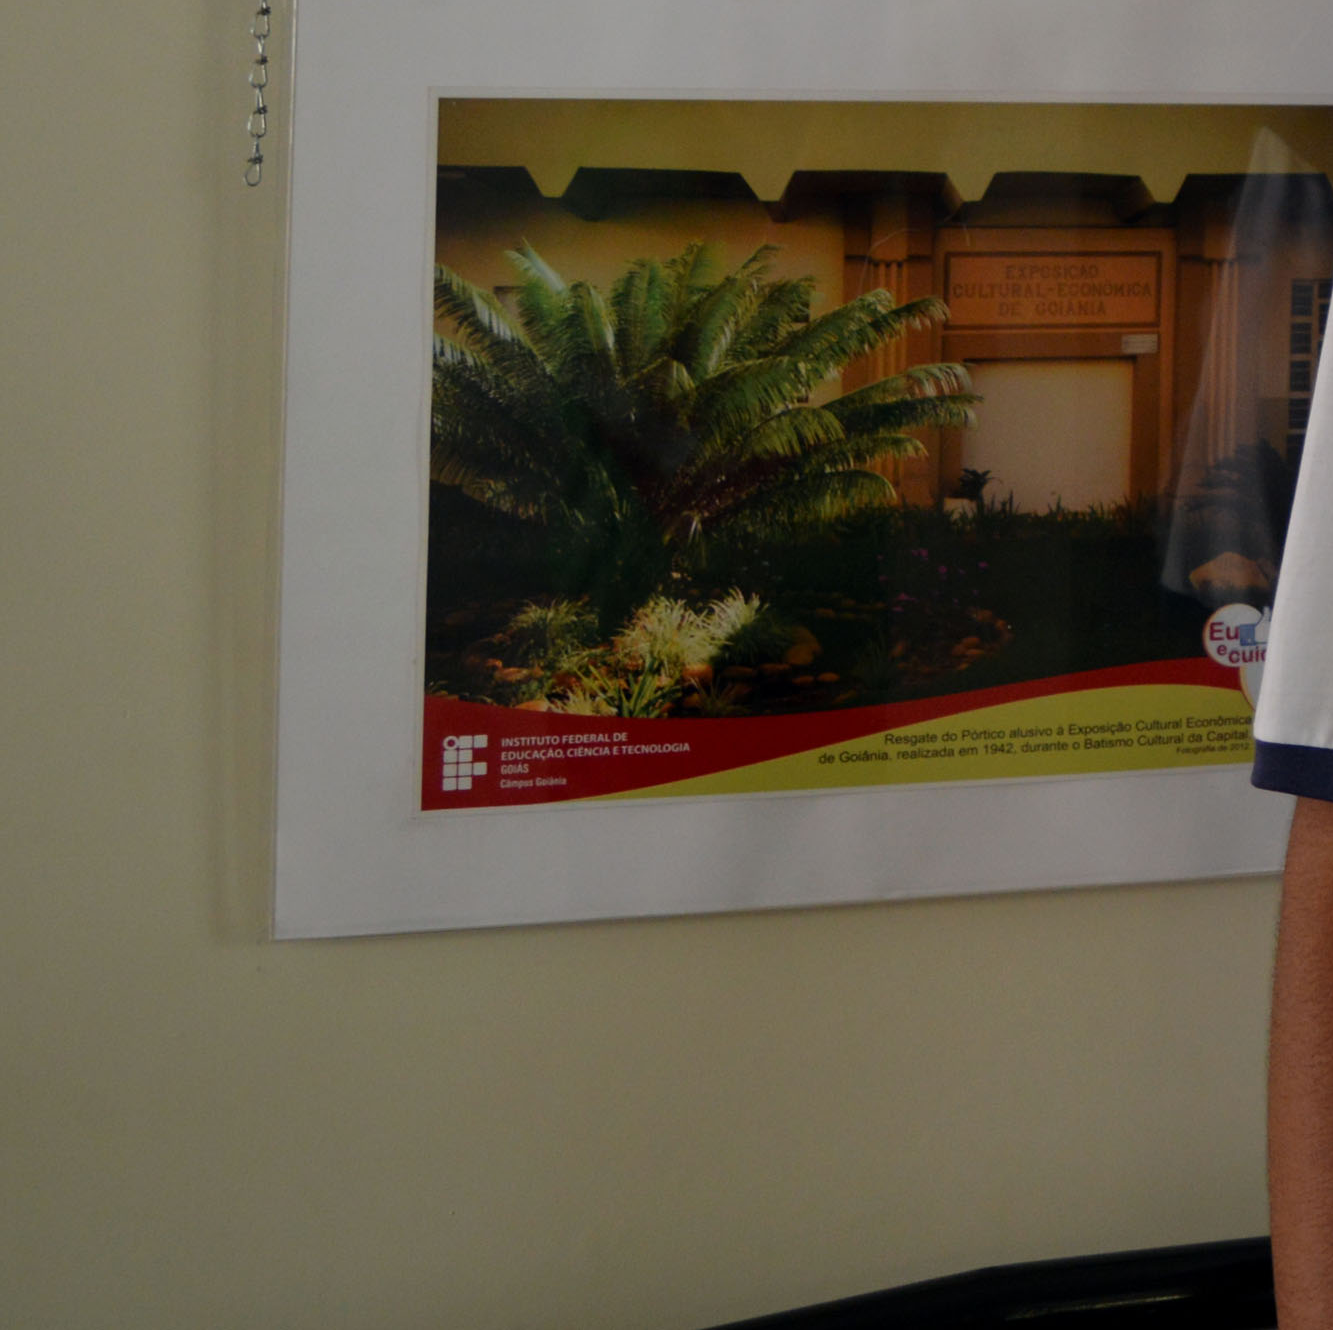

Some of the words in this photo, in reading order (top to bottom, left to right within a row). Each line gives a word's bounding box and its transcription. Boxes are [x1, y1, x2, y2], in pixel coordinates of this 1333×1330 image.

[999, 301, 1022, 316] DE
[1209, 621, 1240, 641] Eu
[1216, 644, 1227, 656] e
[501, 734, 560, 748] INSTITUTO
[562, 732, 611, 745] FEDERAL
[612, 731, 628, 742] DE
[884, 732, 939, 747] Resgate
[941, 730, 958, 743] do
[962, 728, 1005, 742] Pórtico
[1009, 725, 1053, 739] alusivo
[1068, 721, 1132, 737] Exposição
[1135, 718, 1182, 732] Cultural
[1186, 715, 1253, 729] Econômica
[501, 748, 565, 762] EDUCAÇÃO,
[567, 744, 610, 758] CIÊNCIA
[613, 745, 620, 756] E
[621, 742, 691, 756] TECNOLOGIA
[818, 752, 835, 765] de
[839, 749, 893, 763] Goiânia,
[896, 745, 955, 760] realizada
[958, 746, 978, 757] em
[984, 742, 1017, 756] 1942,
[1020, 739, 1068, 754] durante
[1071, 739, 1080, 750] o
[1083, 736, 1134, 750] Batismo
[1137, 732, 1184, 747] Cultural
[1187, 732, 1203, 744] da
[500, 762, 530, 775] GOIÁS
